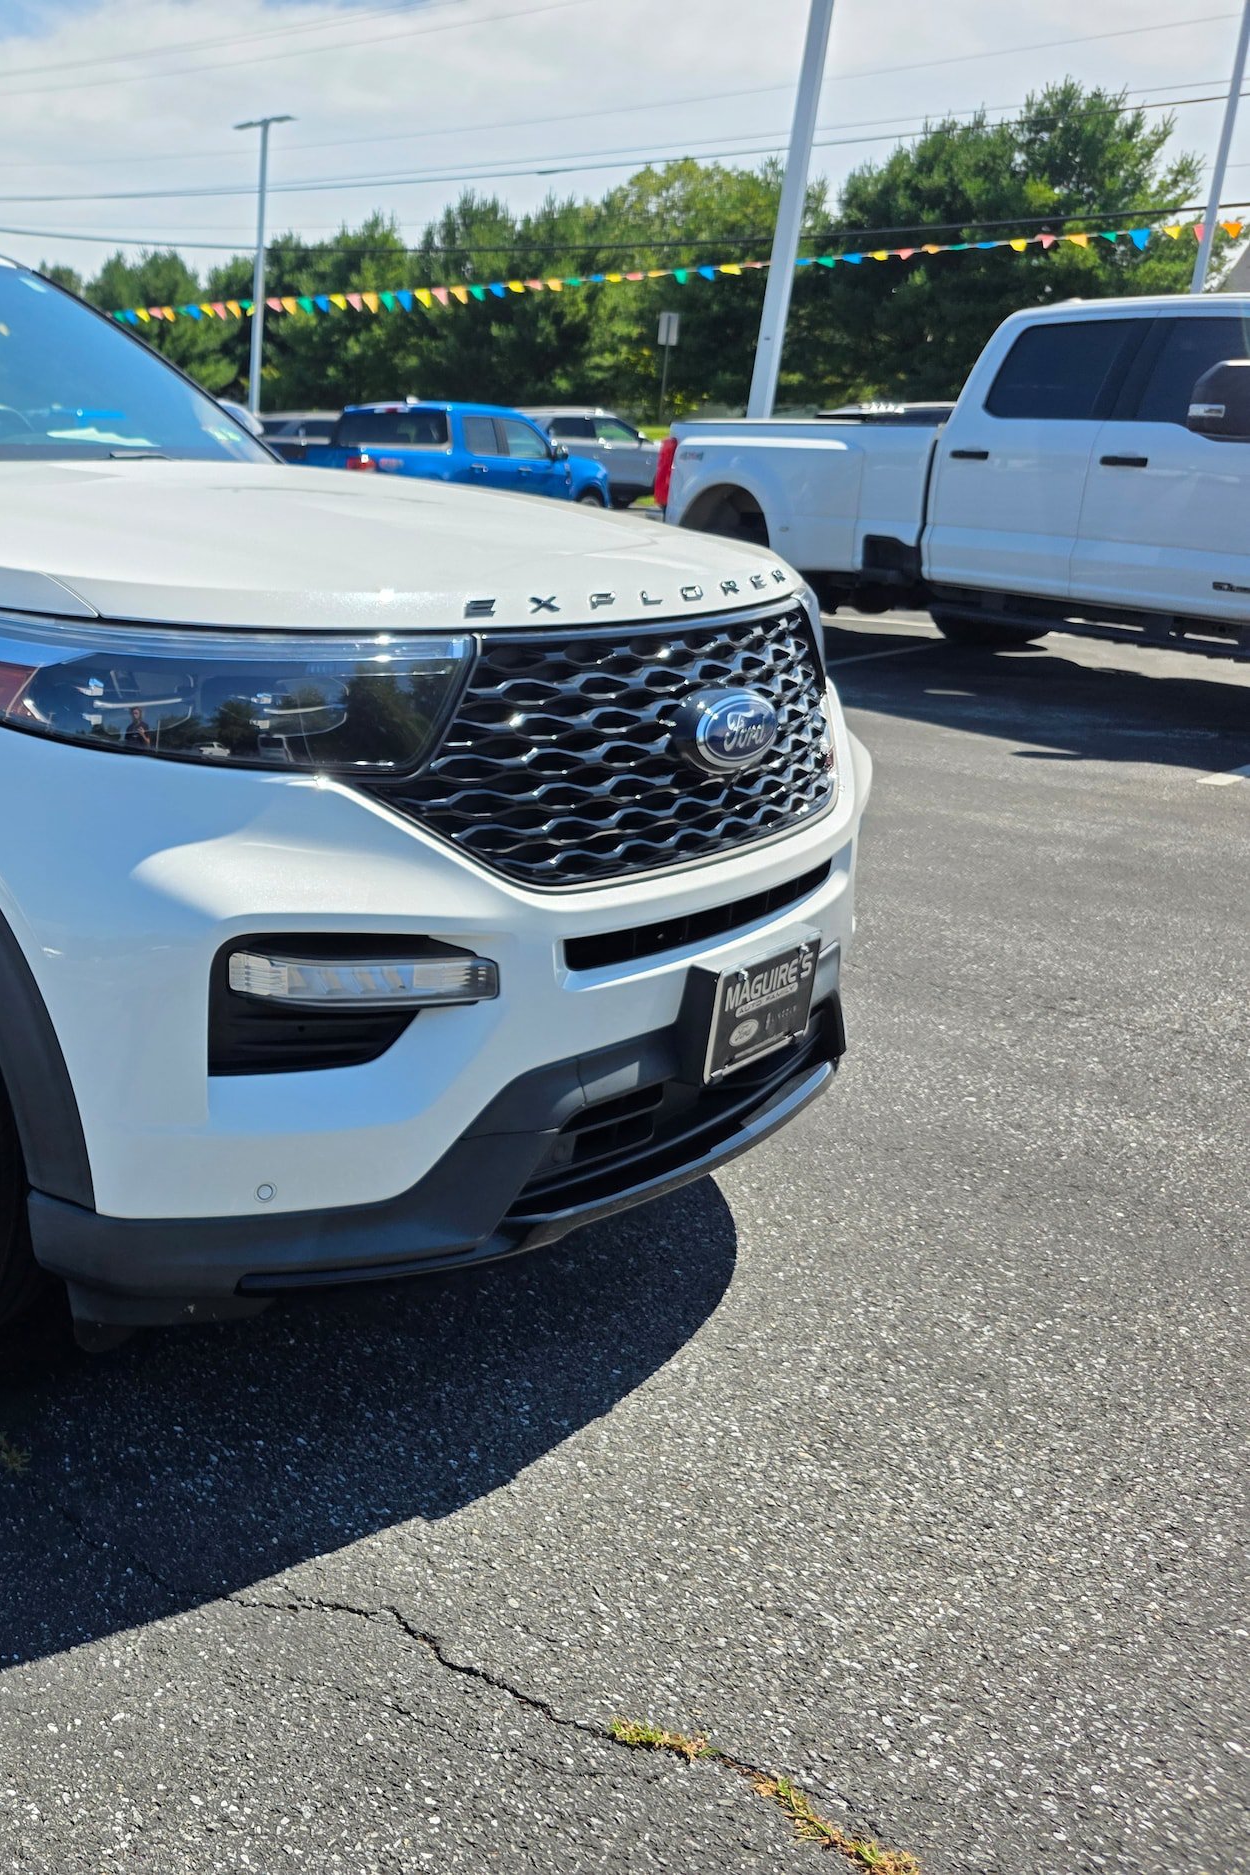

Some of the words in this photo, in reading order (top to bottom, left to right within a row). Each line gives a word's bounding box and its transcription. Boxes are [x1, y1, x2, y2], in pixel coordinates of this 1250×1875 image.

[463, 568, 788, 618] EXPLORER
[723, 709, 768, 752] Ford
[724, 951, 814, 1012] MAGUIRE'S
